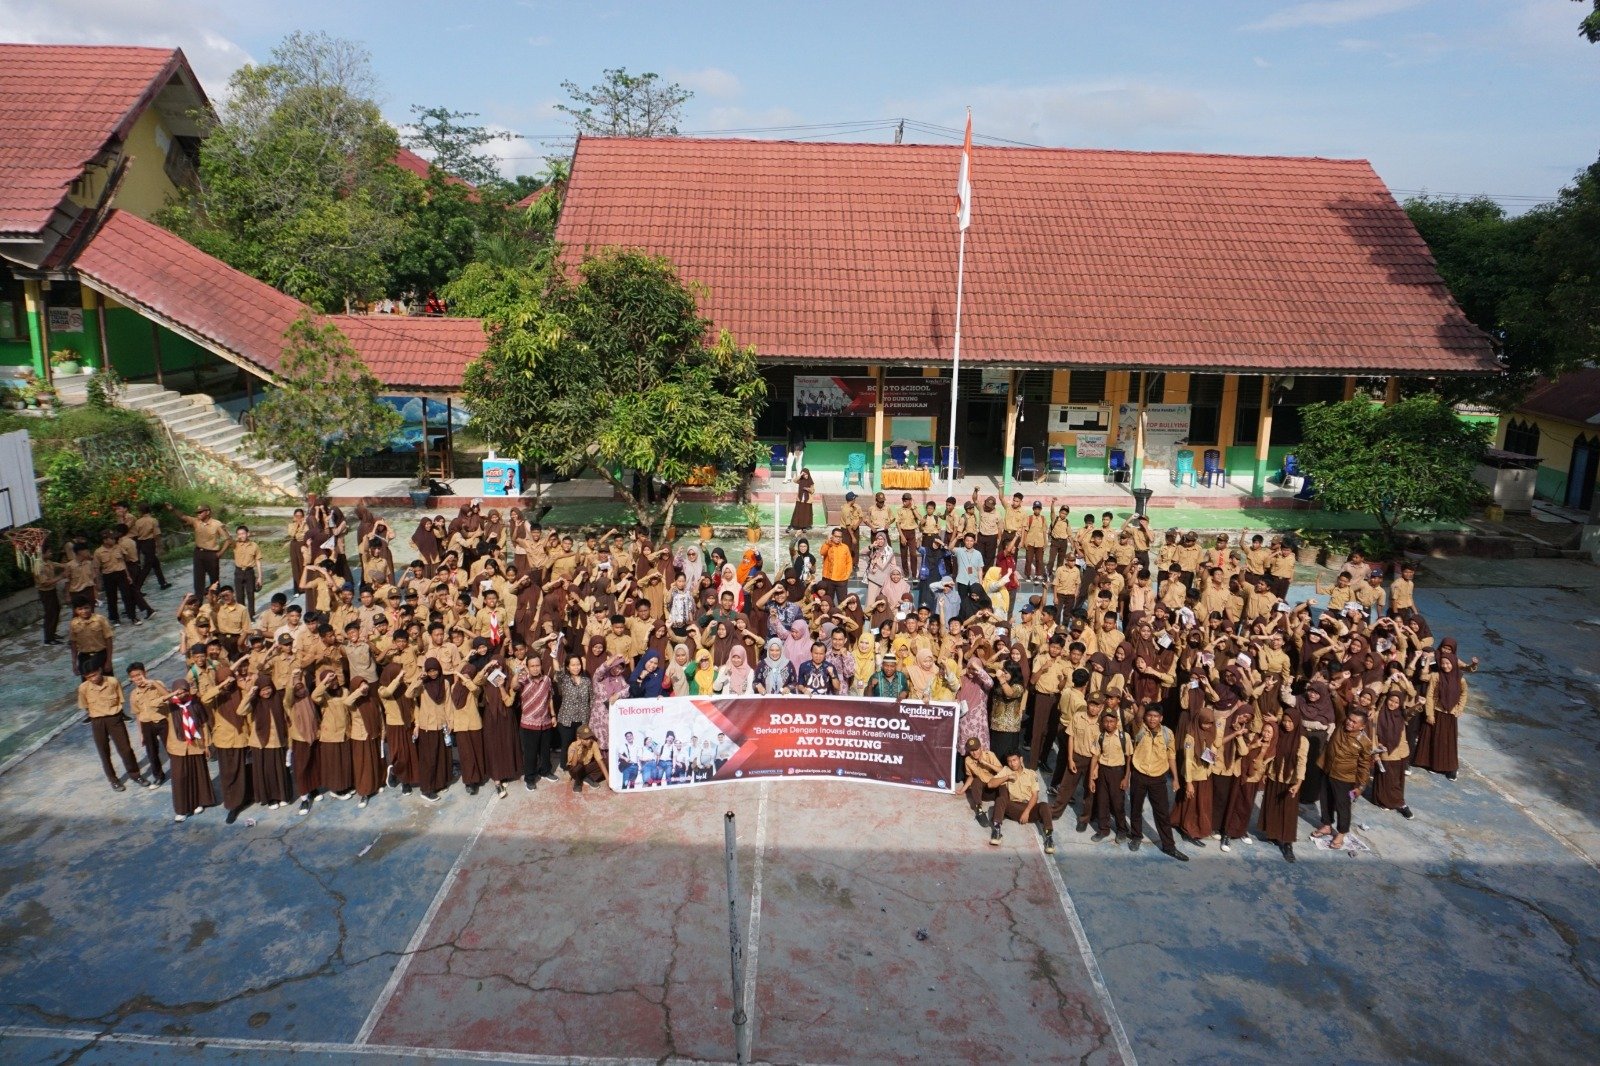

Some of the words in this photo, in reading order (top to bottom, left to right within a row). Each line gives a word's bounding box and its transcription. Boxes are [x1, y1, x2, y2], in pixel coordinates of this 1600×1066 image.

[618, 706, 664, 715] Telkomsel
[900, 705, 935, 717] Kendari
[938, 708, 953, 717] Pos
[770, 714, 816, 726] ROAD
[820, 714, 842, 726] TO
[844, 716, 910, 731] SCHOOL
[790, 727, 817, 735] Dengan
[862, 729, 900, 739] Kreativitas
[796, 736, 823, 745] AYO
[826, 737, 882, 750] DUKUNG
[774, 749, 818, 759] DUNIA
[820, 750, 904, 764] PENDIDIKAN
